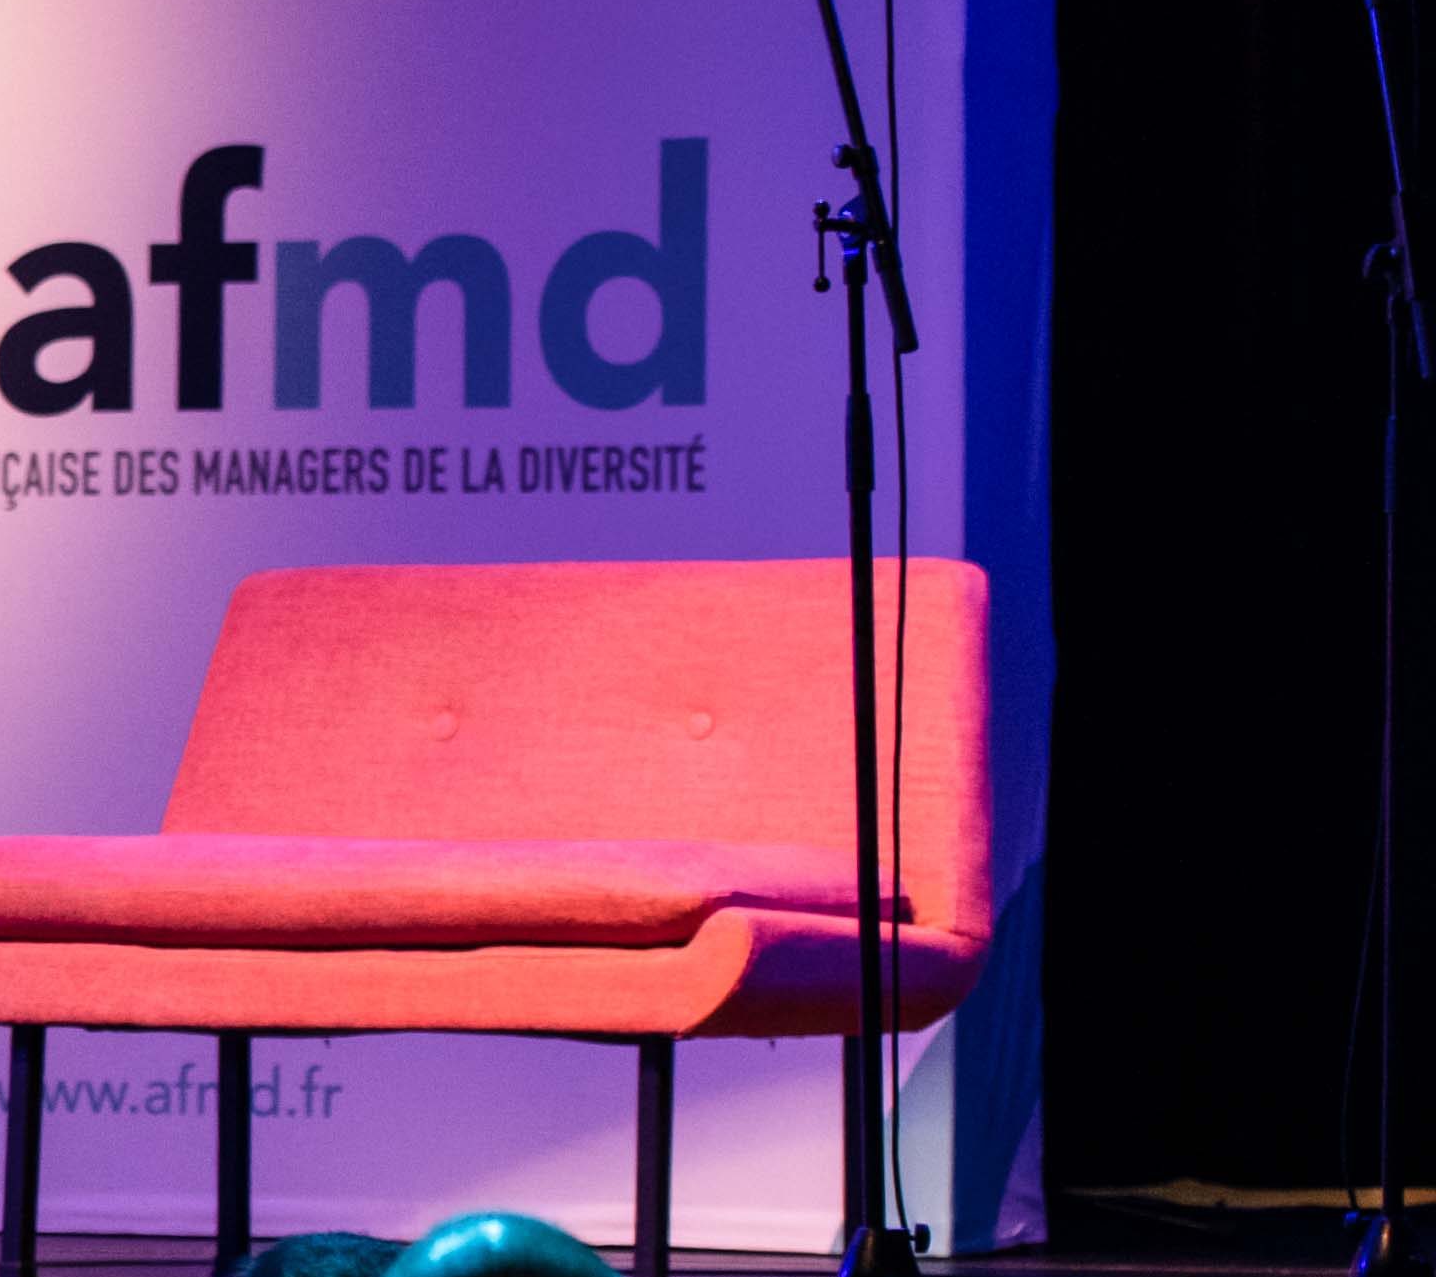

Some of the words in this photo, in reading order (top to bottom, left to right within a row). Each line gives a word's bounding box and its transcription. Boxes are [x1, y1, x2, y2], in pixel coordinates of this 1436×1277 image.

[113, 450, 180, 496] DES
[193, 447, 390, 495] MANAGERS
[403, 445, 448, 494] DE
[461, 445, 506, 493] LA
[519, 434, 706, 493] DIVERSITÉ
